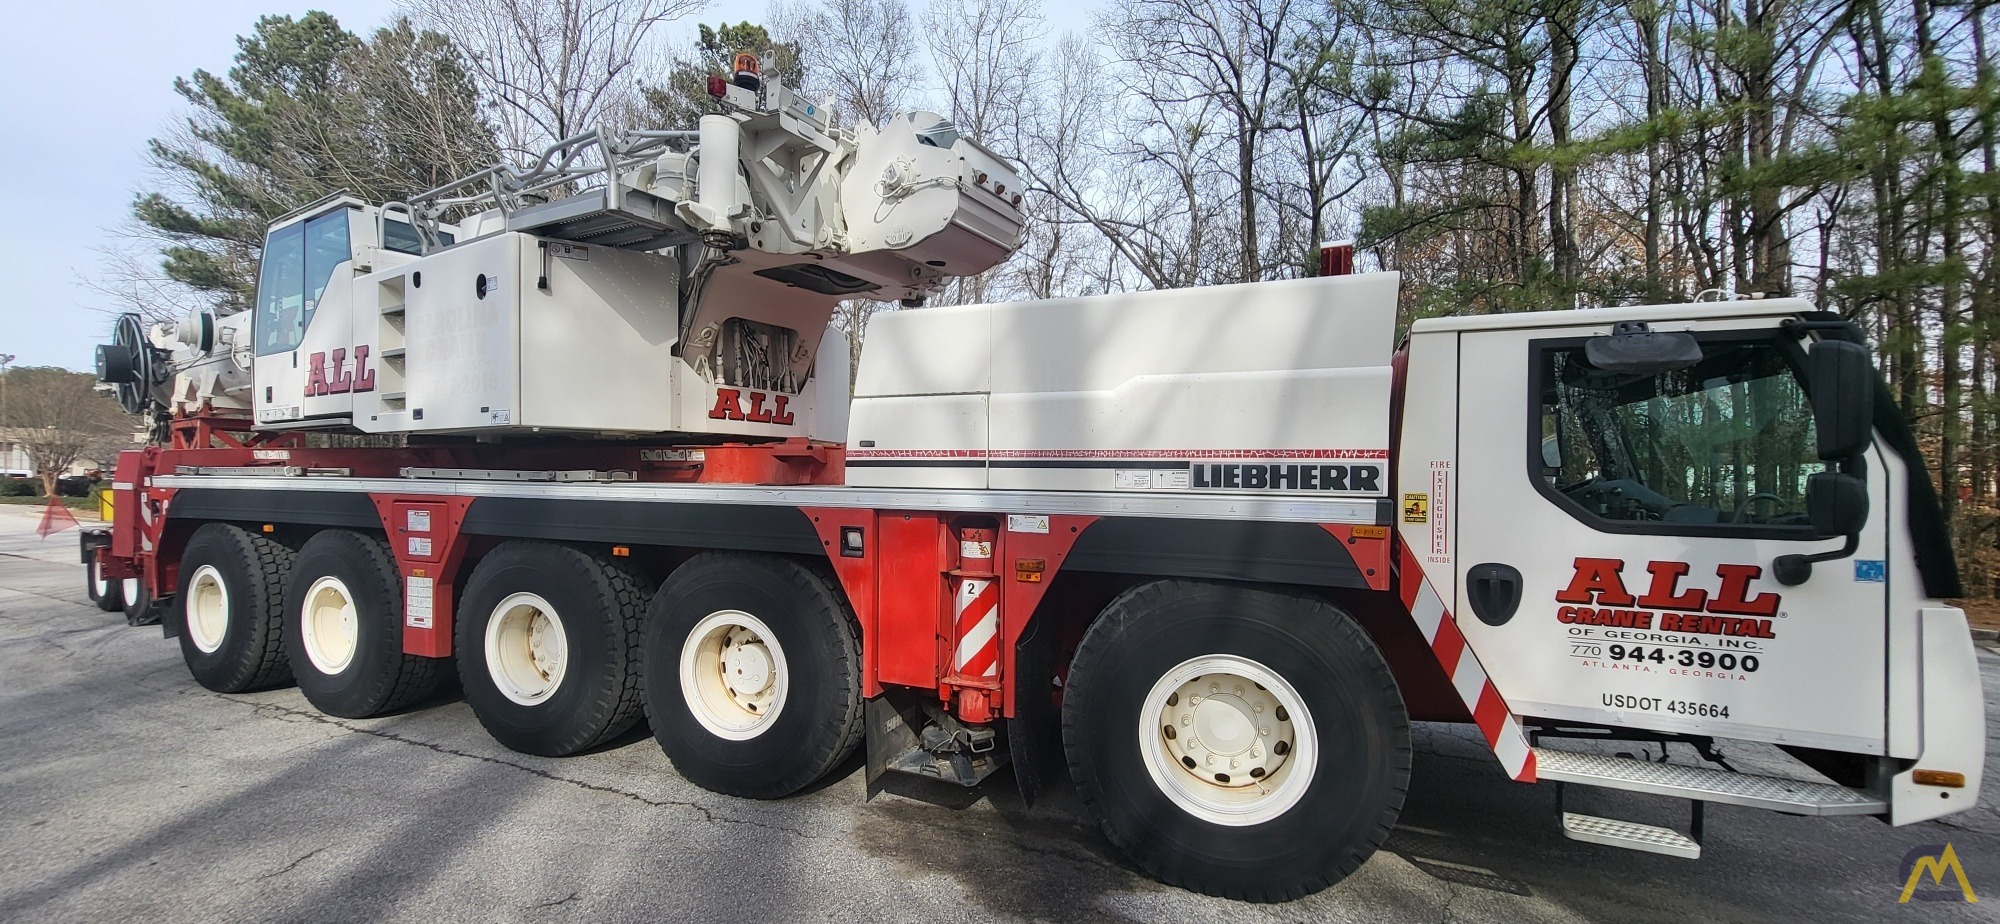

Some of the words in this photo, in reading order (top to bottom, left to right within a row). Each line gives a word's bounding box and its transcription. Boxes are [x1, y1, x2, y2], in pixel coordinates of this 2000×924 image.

[305, 345, 375, 397] ALL
[708, 388, 794, 425] ALL
[1193, 464, 1380, 491] LIEBHERR
[1427, 556, 1450, 564] INSIDE
[967, 582, 975, 595] 2
[1555, 557, 1782, 617] ALL
[1557, 606, 1653, 630] CRANE
[1660, 613, 1776, 639] RENTAL
[1569, 628, 1595, 636] OF
[1604, 630, 1709, 647] GEORGIA,
[1719, 639, 1763, 650] INC.
[1570, 645, 1601, 656] 770
[1669, 668, 1747, 681] GEORGIA
[1602, 693, 1662, 711] USDOT
[1667, 700, 1730, 719] 435664
